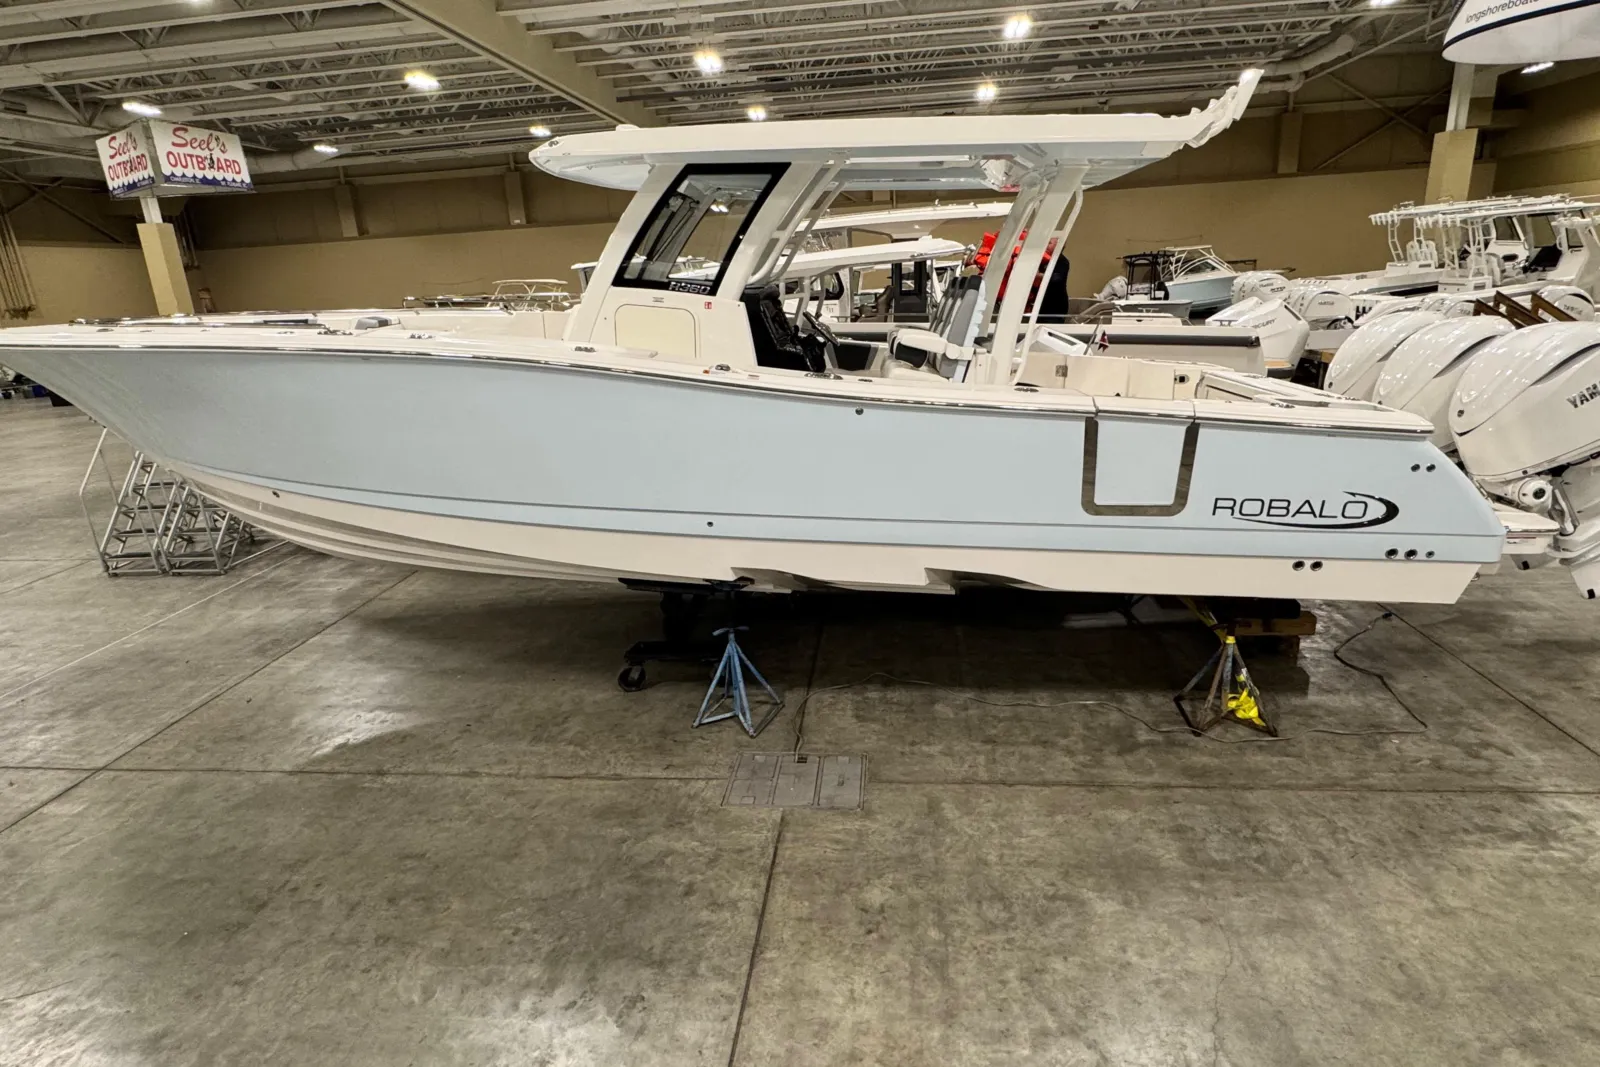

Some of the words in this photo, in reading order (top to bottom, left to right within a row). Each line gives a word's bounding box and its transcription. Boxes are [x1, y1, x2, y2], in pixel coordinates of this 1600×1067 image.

[1465, 0, 1539, 24] longshoreboa
[171, 126, 229, 155] Seel's
[107, 153, 148, 182] OUTBARD
[166, 150, 242, 175] OUTBARD
[668, 281, 711, 295] R360
[1566, 380, 1600, 409] YAM
[1212, 497, 1369, 520] ROBALO
